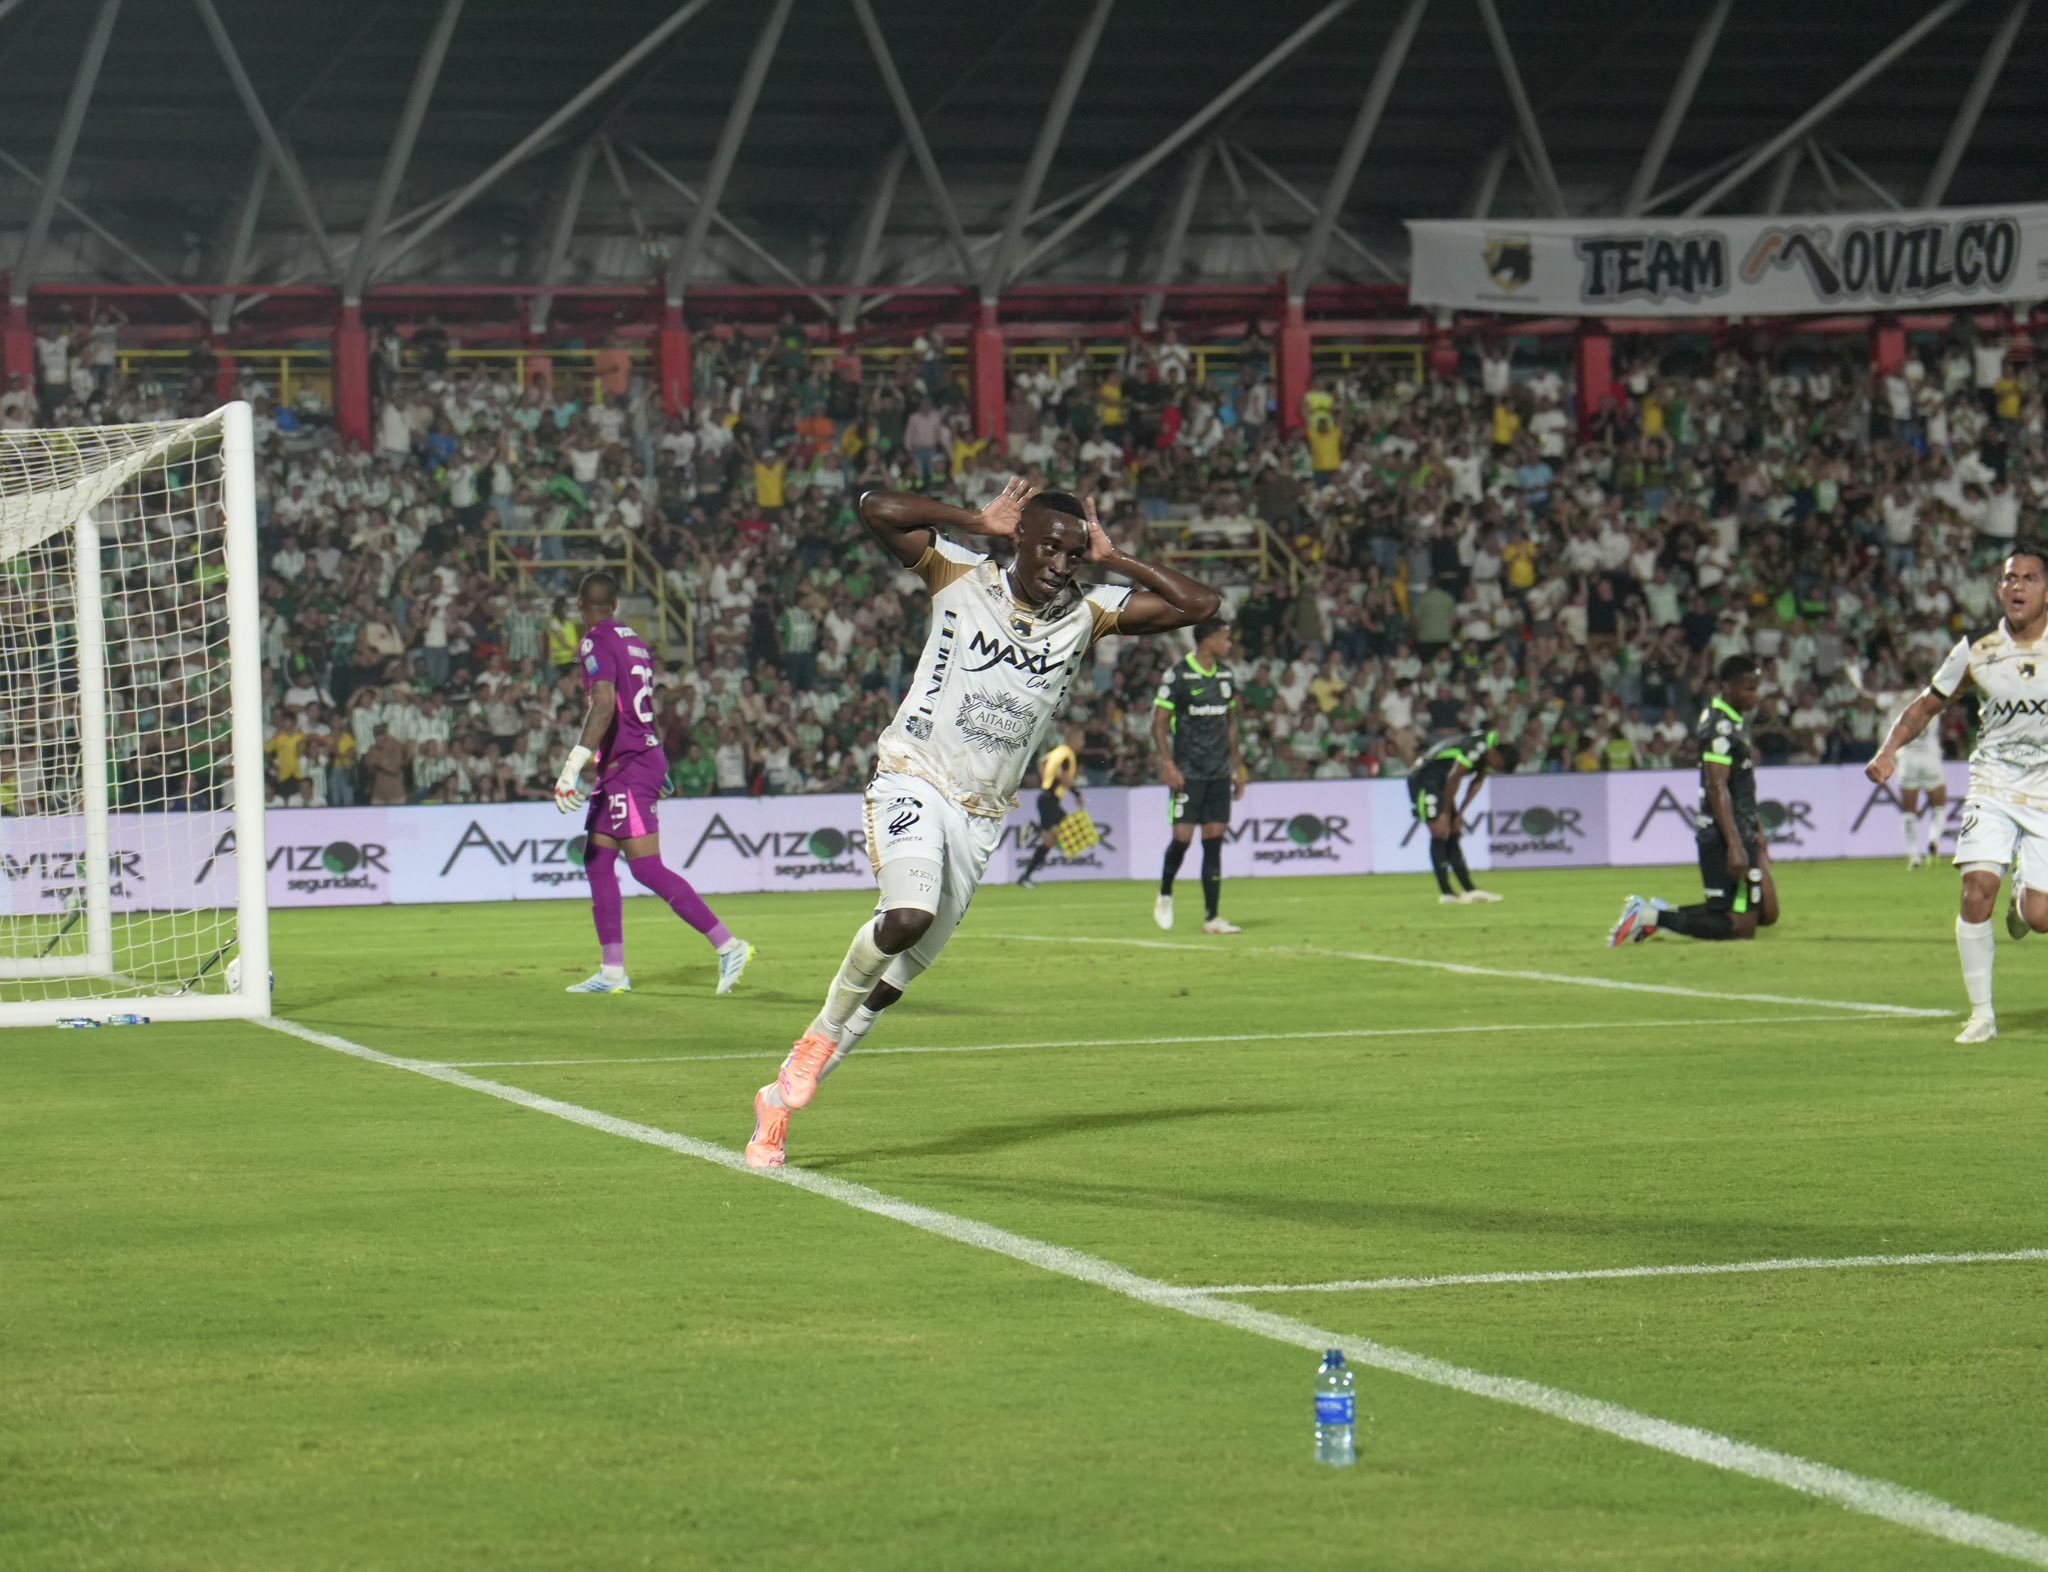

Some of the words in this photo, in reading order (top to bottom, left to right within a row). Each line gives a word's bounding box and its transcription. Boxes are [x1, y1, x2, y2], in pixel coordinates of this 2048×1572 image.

[1579, 237, 1725, 297] TEAM
[919, 610, 957, 715] UNIMETA
[1993, 699, 2048, 729] MAX
[1224, 813, 1353, 845] VIZOR
[775, 861, 855, 879] seguridad
[1254, 847, 1333, 865] seguridad
[288, 874, 369, 894] seguridad
